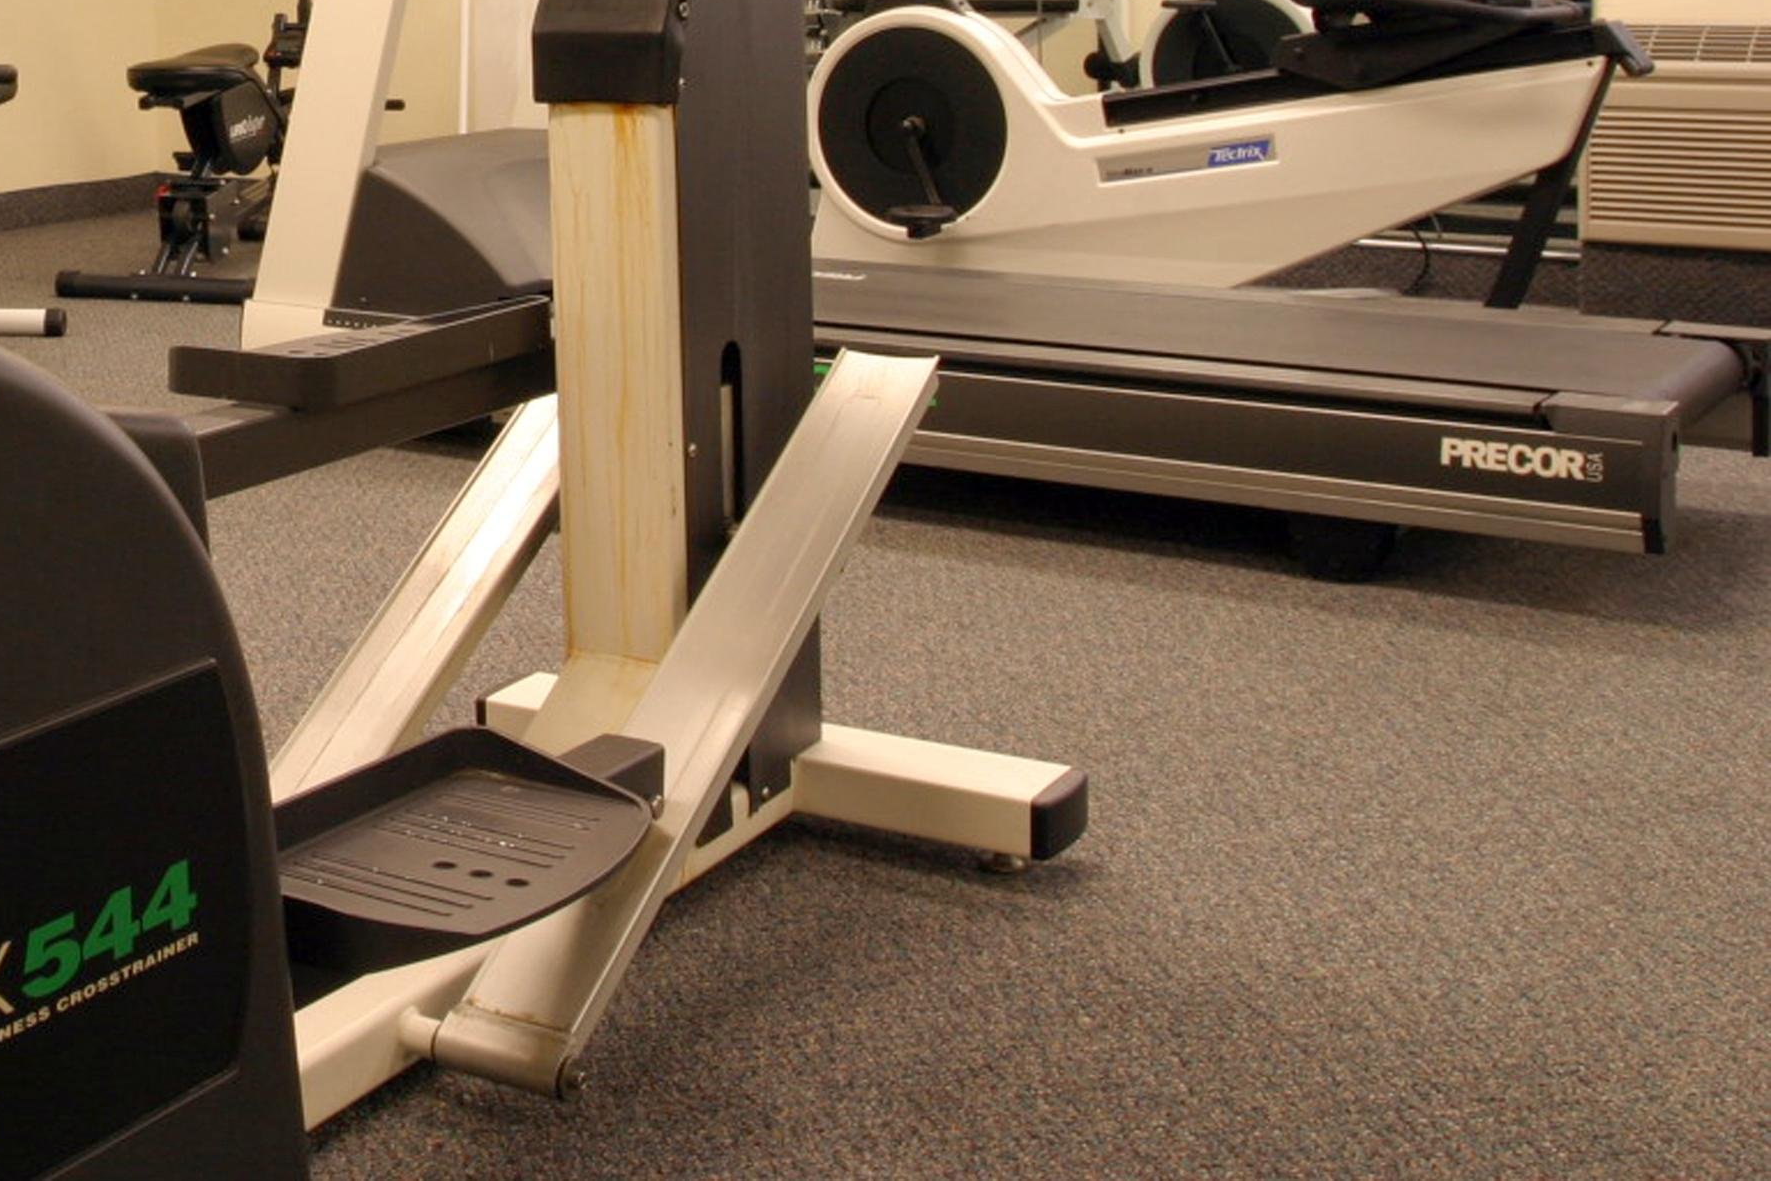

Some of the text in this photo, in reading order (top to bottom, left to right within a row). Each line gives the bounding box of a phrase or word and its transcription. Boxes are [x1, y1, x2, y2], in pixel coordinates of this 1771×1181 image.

[1210, 145, 1265, 162] Tectrix
[1440, 436, 1604, 483] PRECOR USA
[56, 932, 199, 1013] CROSSTRAINER
